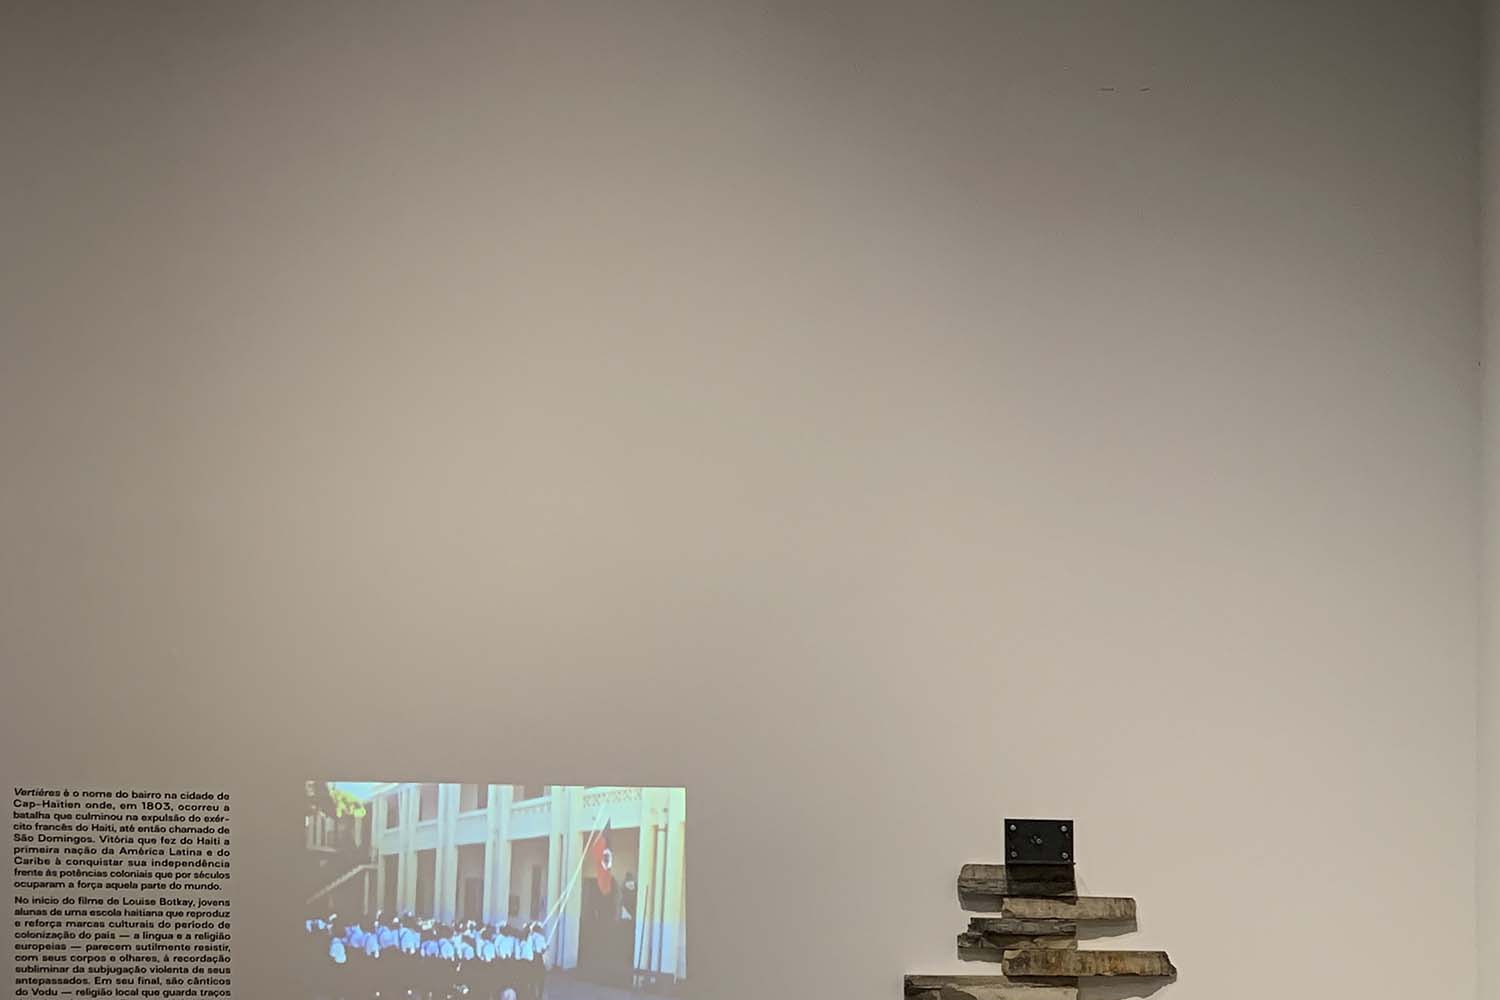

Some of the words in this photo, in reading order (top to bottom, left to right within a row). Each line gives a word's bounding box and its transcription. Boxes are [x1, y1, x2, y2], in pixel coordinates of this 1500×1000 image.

[132, 791, 162, 799] bairro
[180, 791, 214, 800] cidade
[178, 804, 220, 812] ocorreu
[14, 811, 50, 819] batalha
[54, 813, 72, 822] que
[76, 812, 123, 821] culminou
[13, 822, 32, 831] cito
[169, 825, 215, 834] chamado
[217, 826, 230, 834] de
[138, 838, 157, 847] que
[161, 836, 176, 845] fez
[14, 845, 59, 858] primeira
[170, 848, 202, 856] Latina
[217, 849, 230, 857] do
[14, 856, 50, 865] Caribe
[66, 858, 124, 868] conquistar
[14, 868, 43, 876] frente
[110, 870, 153, 878] coloniais
[155, 872, 173, 881] que
[175, 872, 192, 881] por
[14, 882, 66, 890] ocuparam
[106, 881, 138, 891] aquela
[141, 879, 167, 891] parte
[15, 896, 29, 904] No
[78, 896, 104, 905] filme
[107, 897, 119, 906] de
[123, 897, 156, 906] Louise
[199, 898, 230, 909] jovens
[15, 907, 47, 916] alunas
[90, 908, 122, 917] escola
[124, 909, 163, 917] haitiana
[166, 911, 184, 919] que
[186, 907, 230, 920] reproduz
[108, 920, 154, 928] culturais
[218, 921, 230, 929] de
[14, 943, 67, 952] europeias
[86, 944, 132, 953] parecem
[136, 941, 191, 951] sutilmente
[70, 955, 106, 964] corpos
[16, 965, 70, 973] subliminar
[150, 965, 189, 974] violenta
[192, 966, 204, 974] de
[94, 976, 112, 985] Em
[32, 988, 58, 996] Vodu
[115, 988, 139, 997] local
[142, 990, 160, 999] que
[162, 988, 198, 998] guarda
